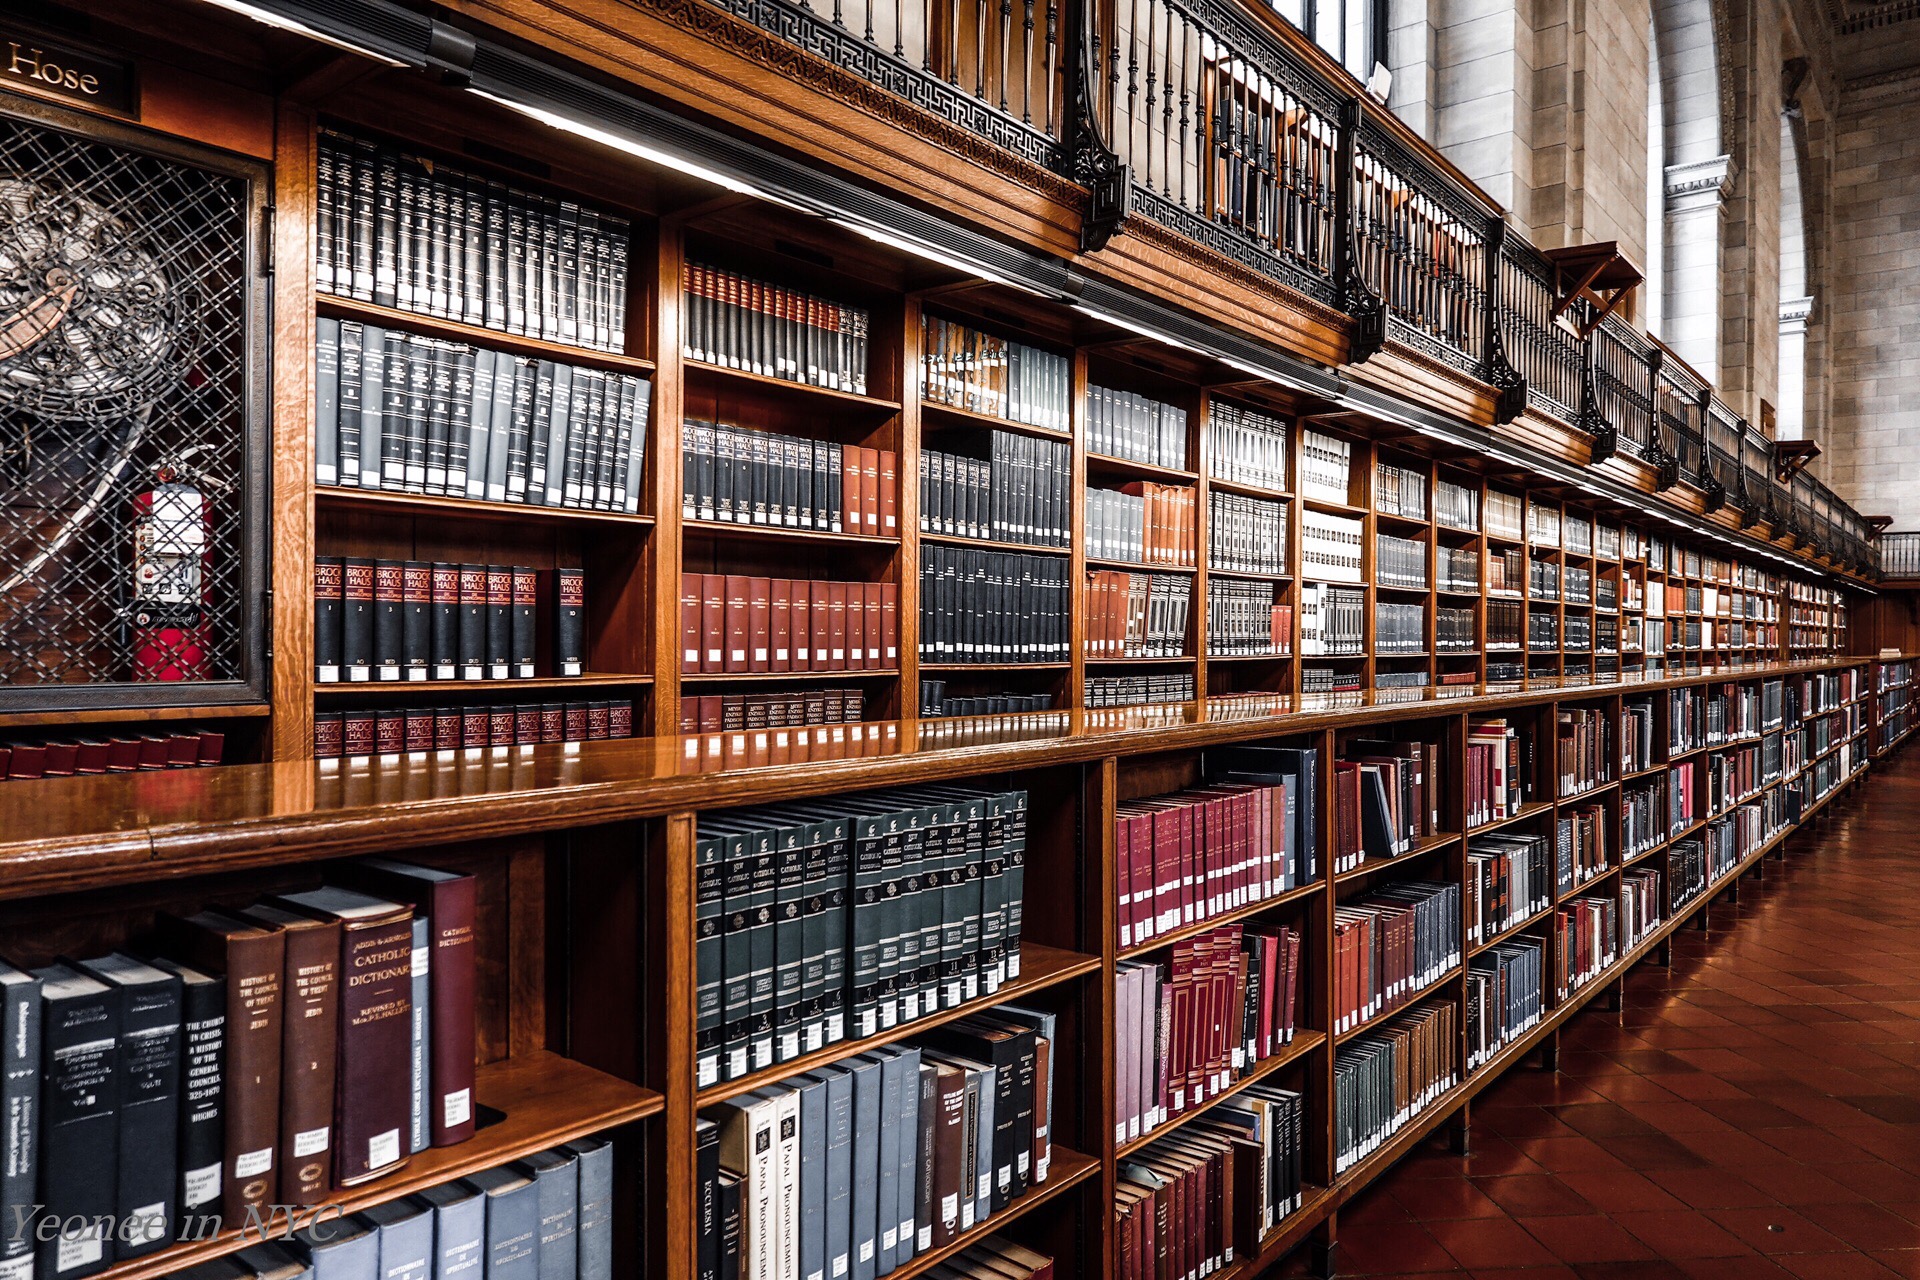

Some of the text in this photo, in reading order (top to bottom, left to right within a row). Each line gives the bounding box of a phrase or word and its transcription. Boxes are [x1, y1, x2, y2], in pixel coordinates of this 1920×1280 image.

[9, 42, 98, 94] Hose
[315, 568, 342, 576] BROCK
[347, 569, 373, 577] BROCK
[376, 571, 403, 579] BROCK
[405, 572, 430, 580] BROCK
[350, 578, 371, 586] HAUS
[462, 574, 486, 582] BROCK
[488, 576, 511, 584] BROCK
[408, 580, 428, 588] HAUS
[464, 582, 484, 590] HAUS
[517, 584, 534, 592] HAUS
[754, 868, 775, 878] CATHOLIC
[781, 865, 802, 873] CATHOLIC
[699, 879, 721, 888] CATHOLIC
[728, 873, 749, 883] CATHOLIC
[355, 947, 410, 967] CATHOLIC
[299, 965, 324, 976] HISTORY
[240, 976, 267, 987] HISTORY
[296, 974, 333, 987] THE COUNCIL
[240, 983, 278, 997] THE COUNCIL
[300, 985, 328, 996] OF TRENT
[361, 1001, 395, 1016] REVISED
[186, 1016, 225, 1031] THE CHURCH
[190, 1034, 198, 1042] IN
[196, 1040, 222, 1053] HISTORY
[193, 1053, 216, 1065] OF THE
[189, 1064, 219, 1077] GENERAL
[311, 1062, 317, 1070] 2
[188, 1086, 220, 1100] 325-1870
[192, 1109, 217, 1123] HUGHES
[784, 1142, 793, 1182] PAPAL
[758, 1155, 768, 1194] PAPAL
[704, 1180, 712, 1237] ECCLESIA
[446, 1239, 479, 1257] DICTIONNAIRE
[459, 1252, 467, 1261] DE
[388, 1258, 425, 1278] DICTIONNAIRE
